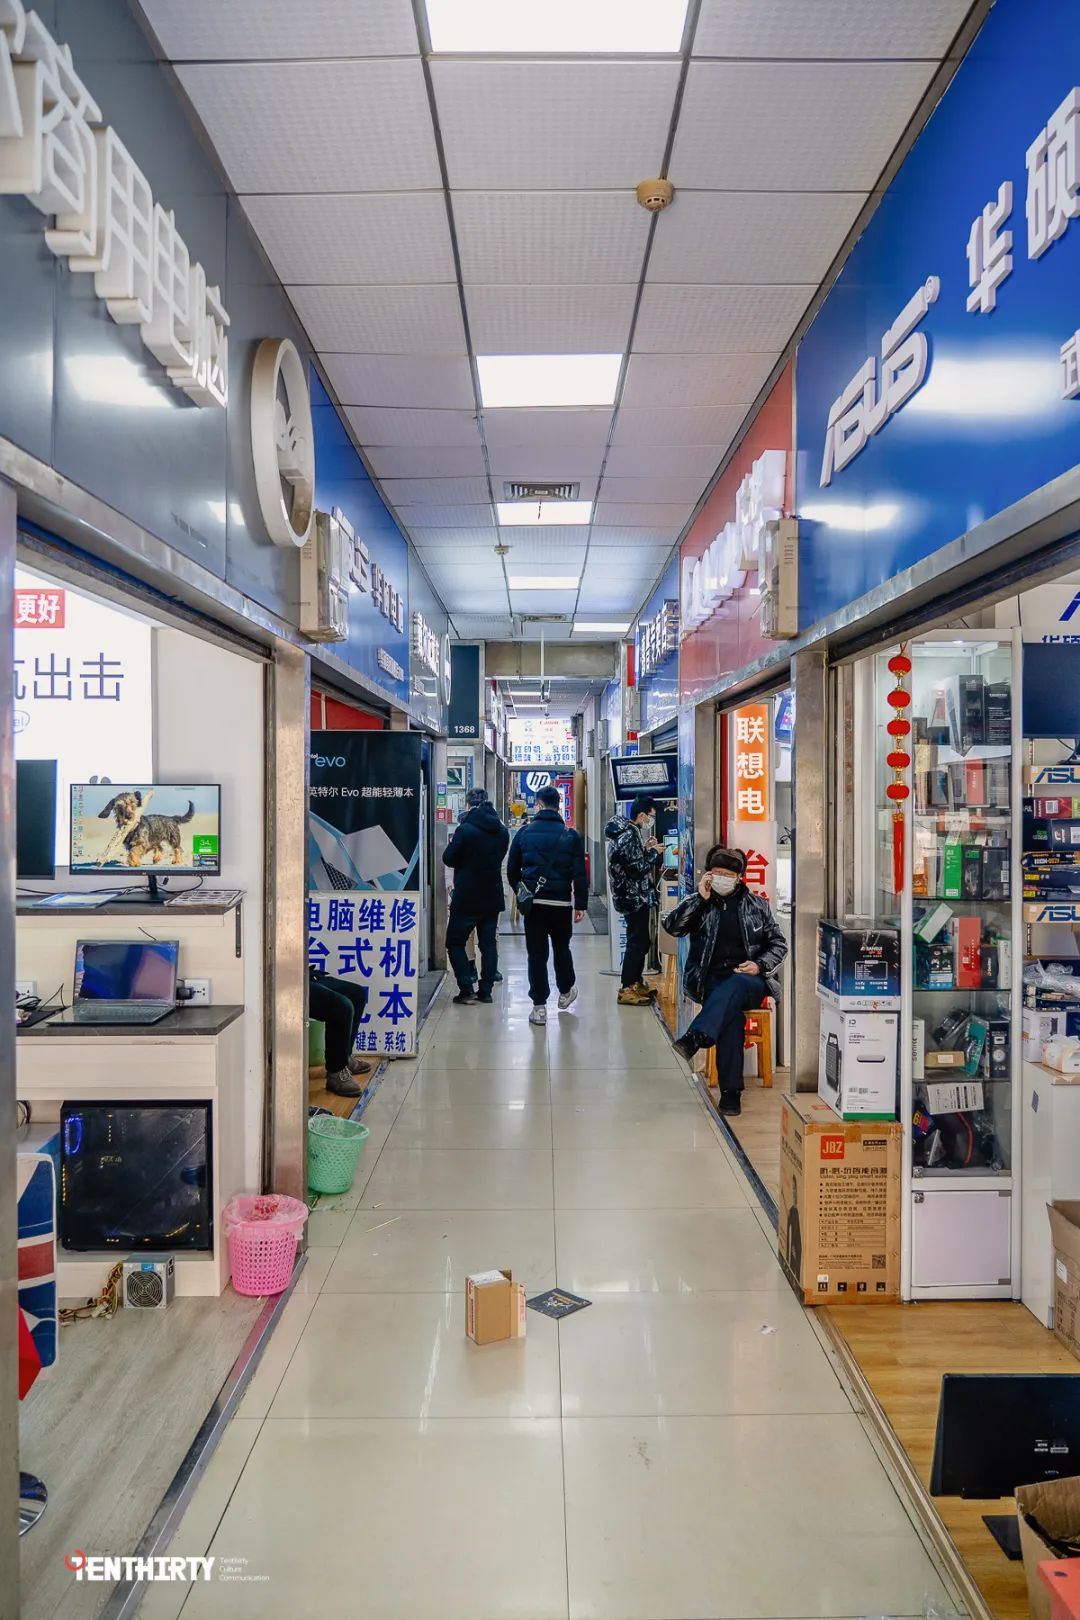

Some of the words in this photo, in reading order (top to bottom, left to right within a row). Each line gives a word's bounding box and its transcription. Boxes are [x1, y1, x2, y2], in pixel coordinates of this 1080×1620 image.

[0, 0, 230, 408] 商用电脑
[16, 594, 60, 625] 更好
[454, 725, 475, 733] 1368
[314, 756, 346, 767] evo
[736, 716, 764, 815] 联想电
[529, 771, 548, 788] hp
[341, 787, 359, 797] Evo
[361, 787, 414, 798] 超能轻薄本
[359, 983, 414, 1026] 本
